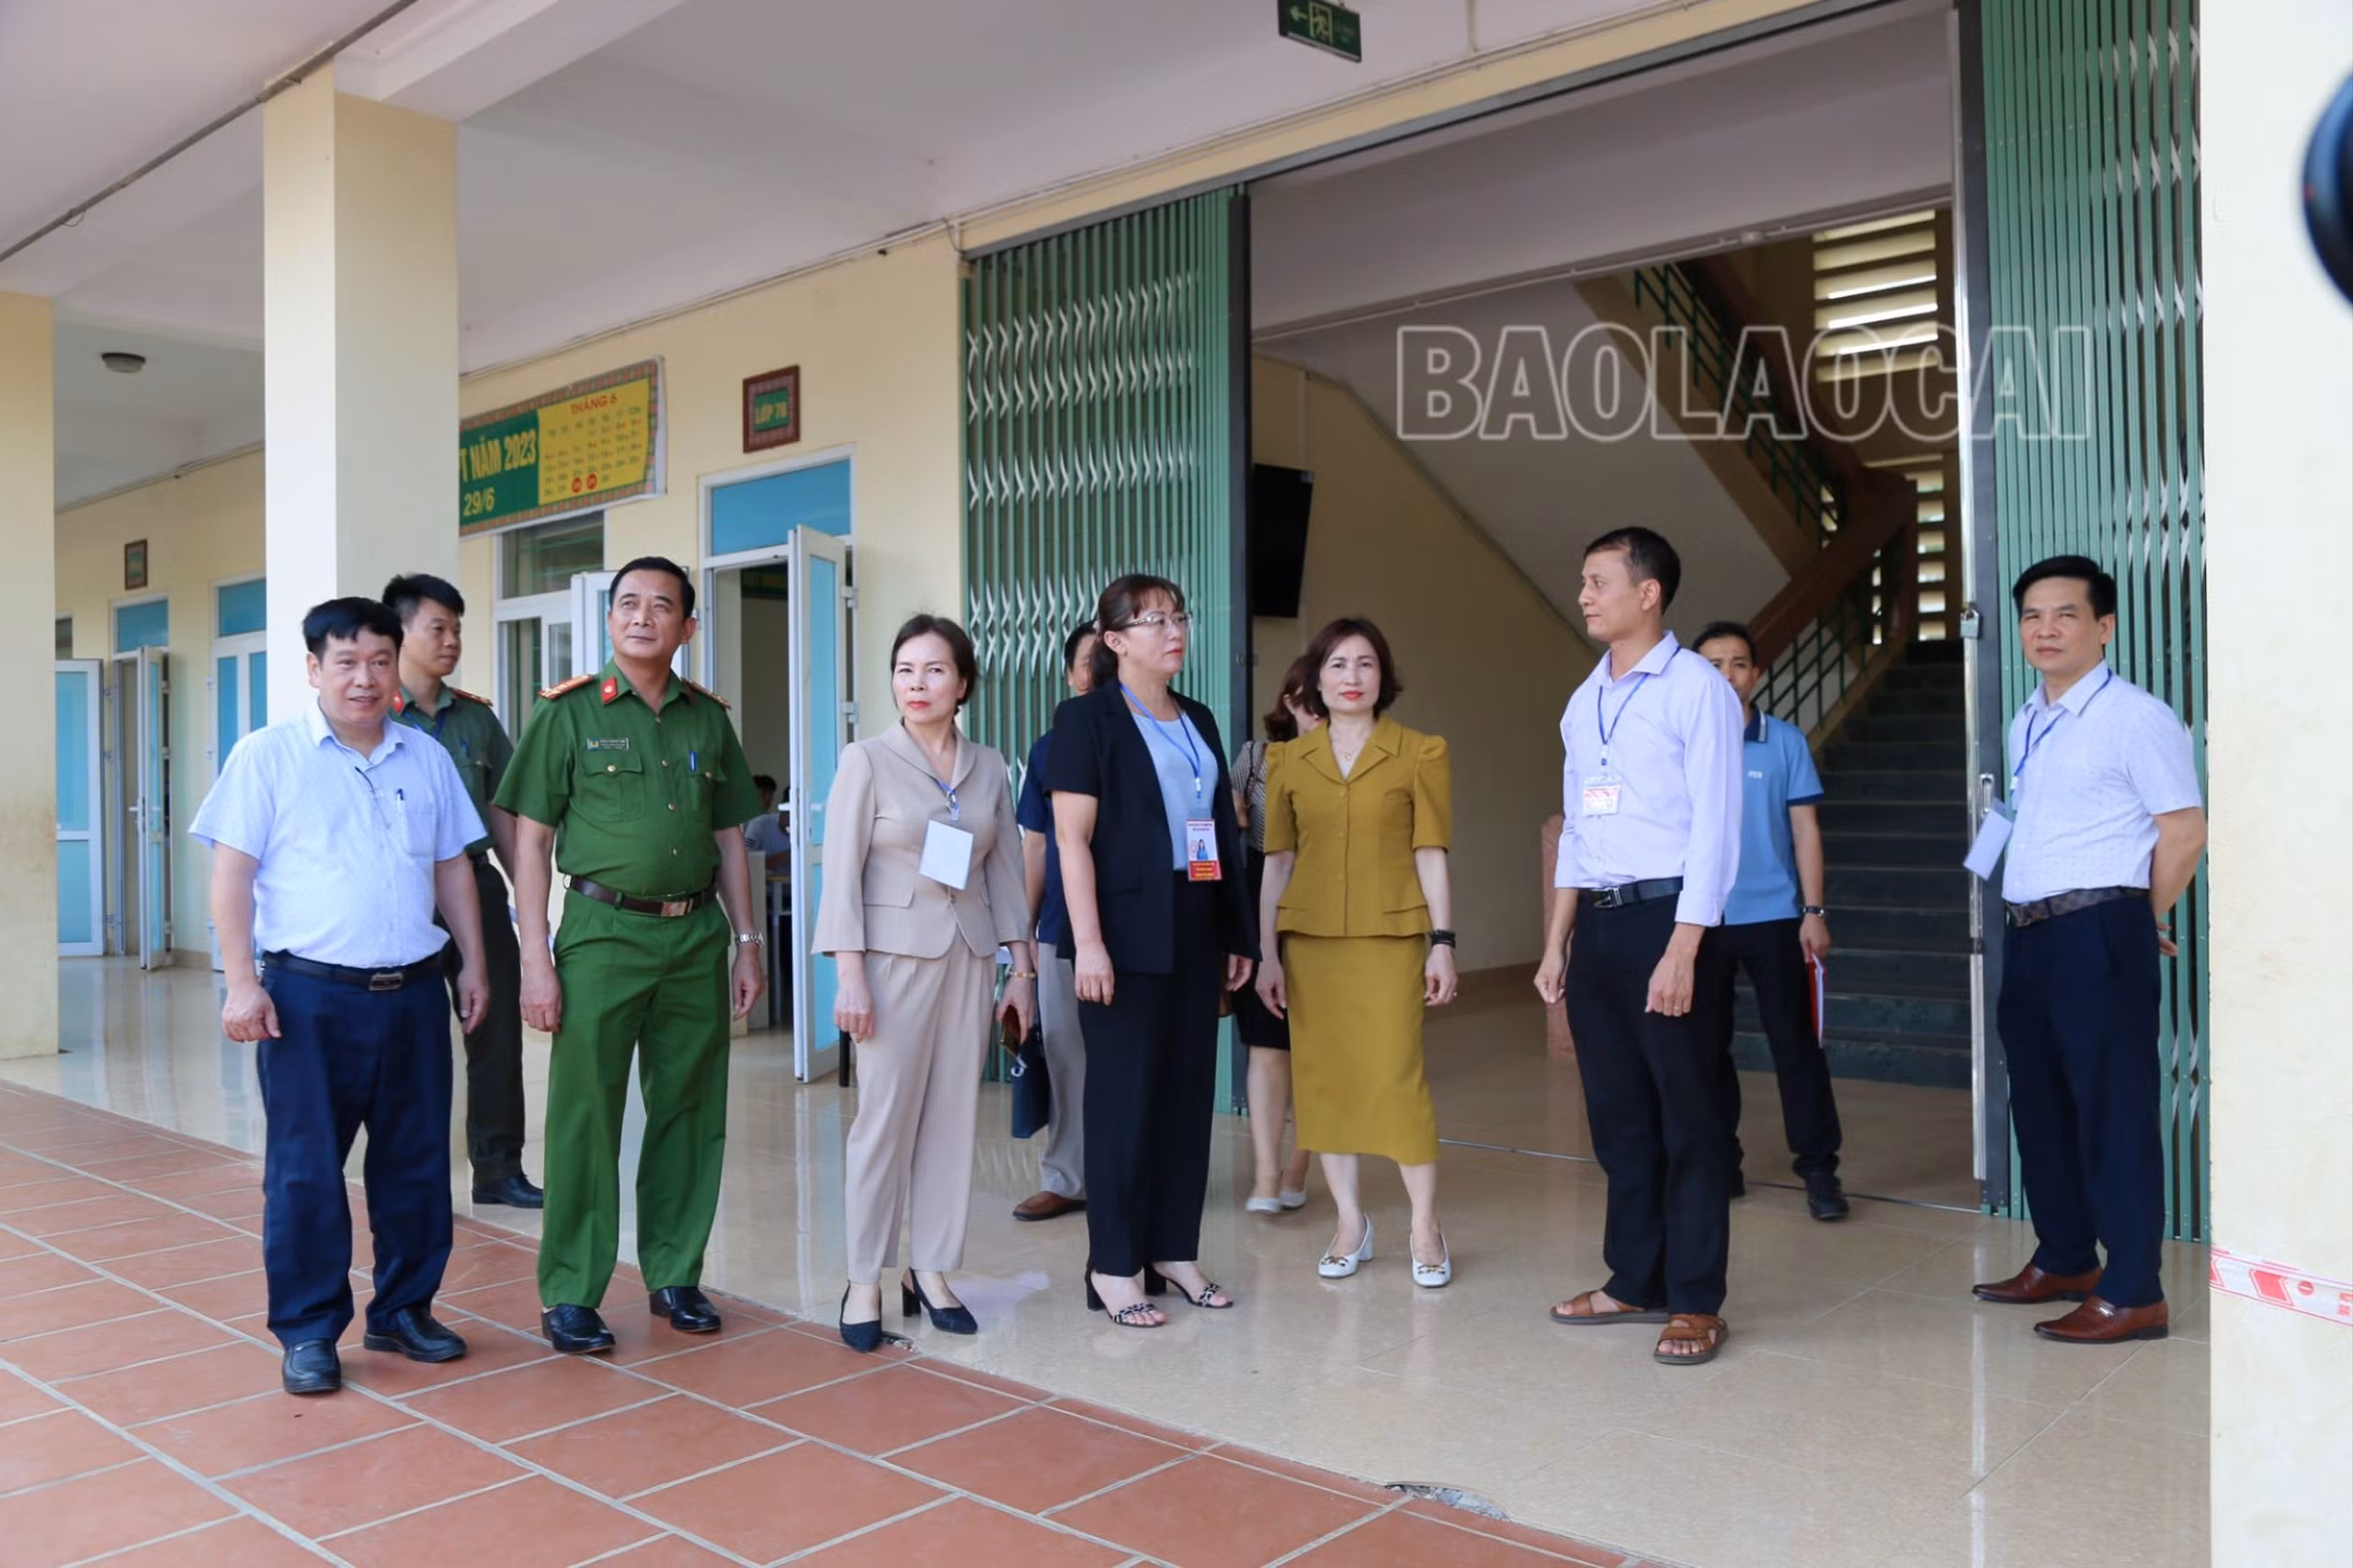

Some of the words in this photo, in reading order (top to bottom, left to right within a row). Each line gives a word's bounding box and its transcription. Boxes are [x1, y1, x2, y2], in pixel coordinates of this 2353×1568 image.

[571, 395, 608, 415] THÁNG
[610, 393, 618, 404] 6
[470, 436, 502, 480] NĂM
[504, 429, 536, 471] 2023
[463, 487, 494, 517] 29/6
